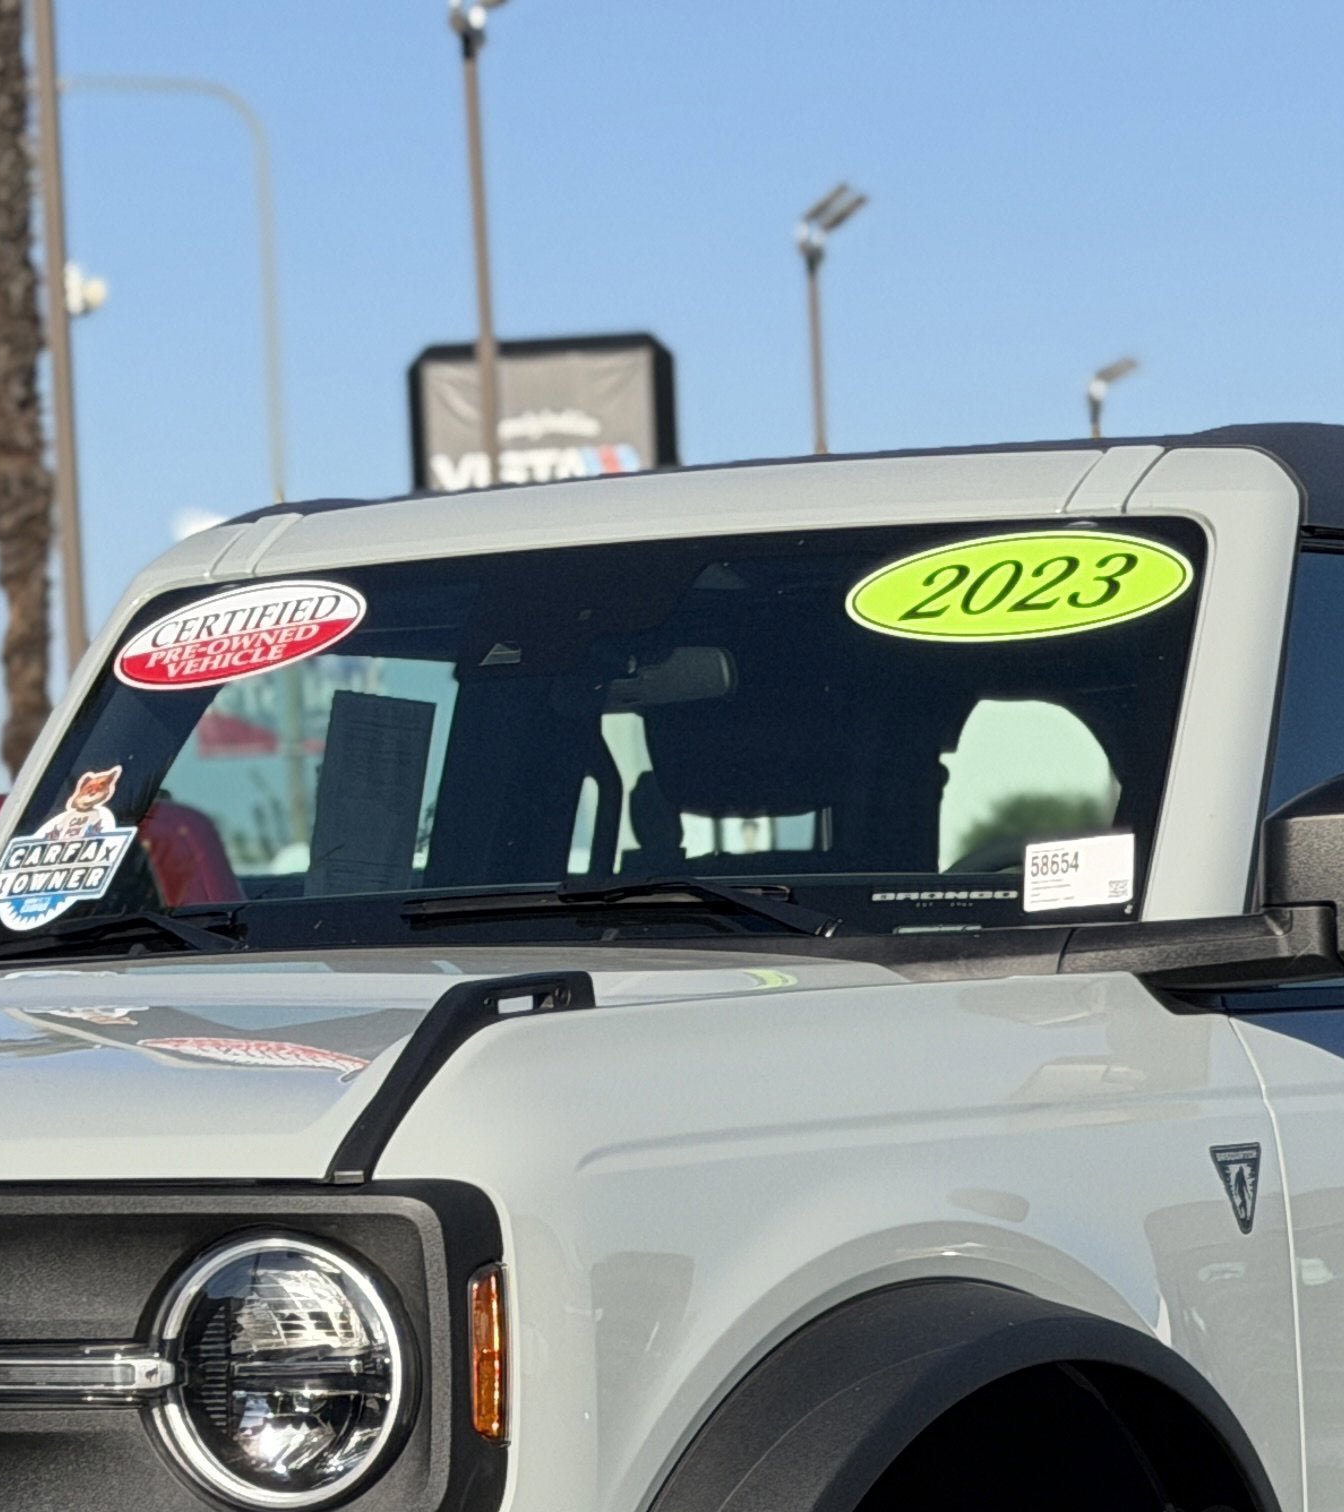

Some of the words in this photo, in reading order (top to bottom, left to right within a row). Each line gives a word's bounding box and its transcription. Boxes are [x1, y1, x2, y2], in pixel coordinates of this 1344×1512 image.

[897, 553, 1139, 622] 2023
[151, 594, 342, 648] CERTIFIED
[145, 623, 320, 668] PRE-OWNED
[166, 643, 287, 678] VEHICLE
[8, 840, 117, 868] CARFAX
[1030, 851, 1079, 877] 58654
